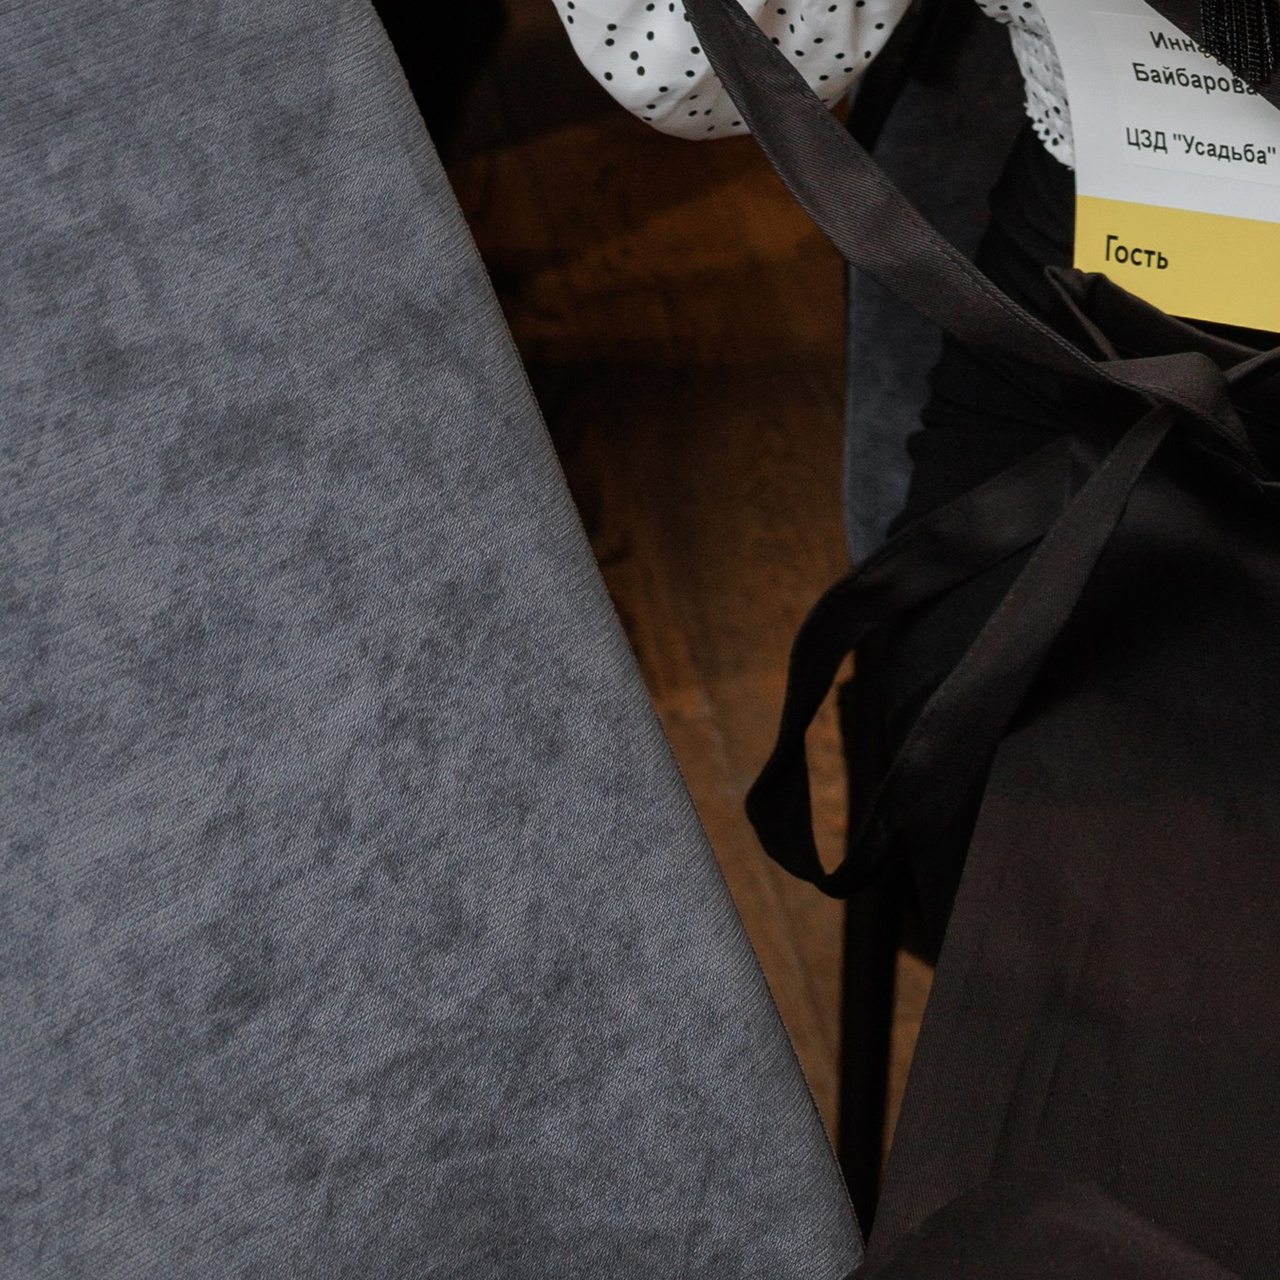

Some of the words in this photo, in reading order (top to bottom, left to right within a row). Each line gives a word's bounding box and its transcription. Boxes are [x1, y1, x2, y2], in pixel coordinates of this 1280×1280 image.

[1126, 127, 1168, 154] ЦЗД
[1173, 133, 1276, 165] "Усадьба"
[1104, 234, 1169, 271] Гость
